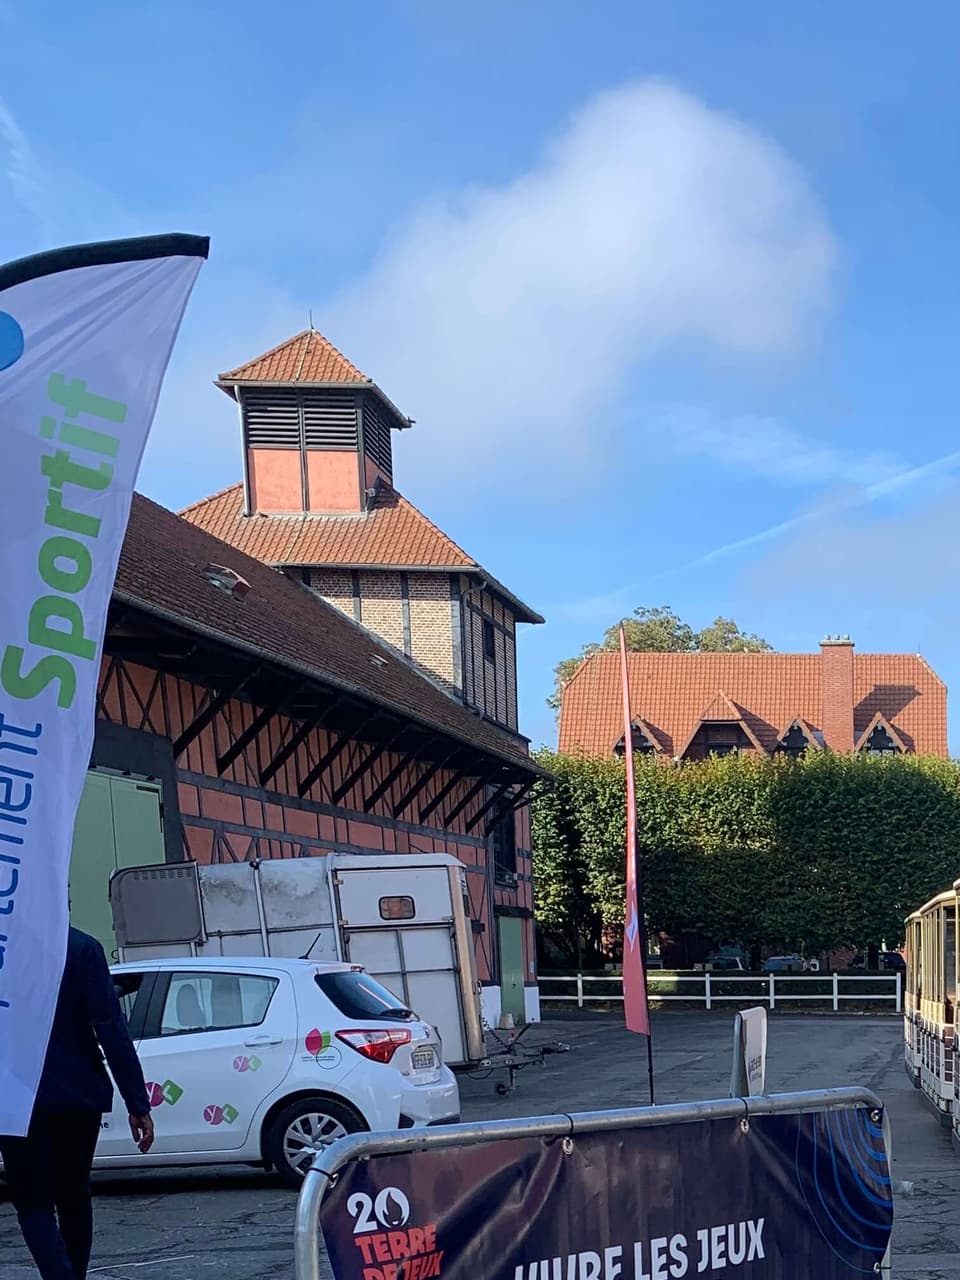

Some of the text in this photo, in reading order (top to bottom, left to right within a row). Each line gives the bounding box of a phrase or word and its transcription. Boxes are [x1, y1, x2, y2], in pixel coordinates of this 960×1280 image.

[1, 372, 128, 710] Sportif
[347, 1186, 410, 1233] 20
[355, 1224, 437, 1264] TERRE
[697, 1218, 765, 1272] JEUX
